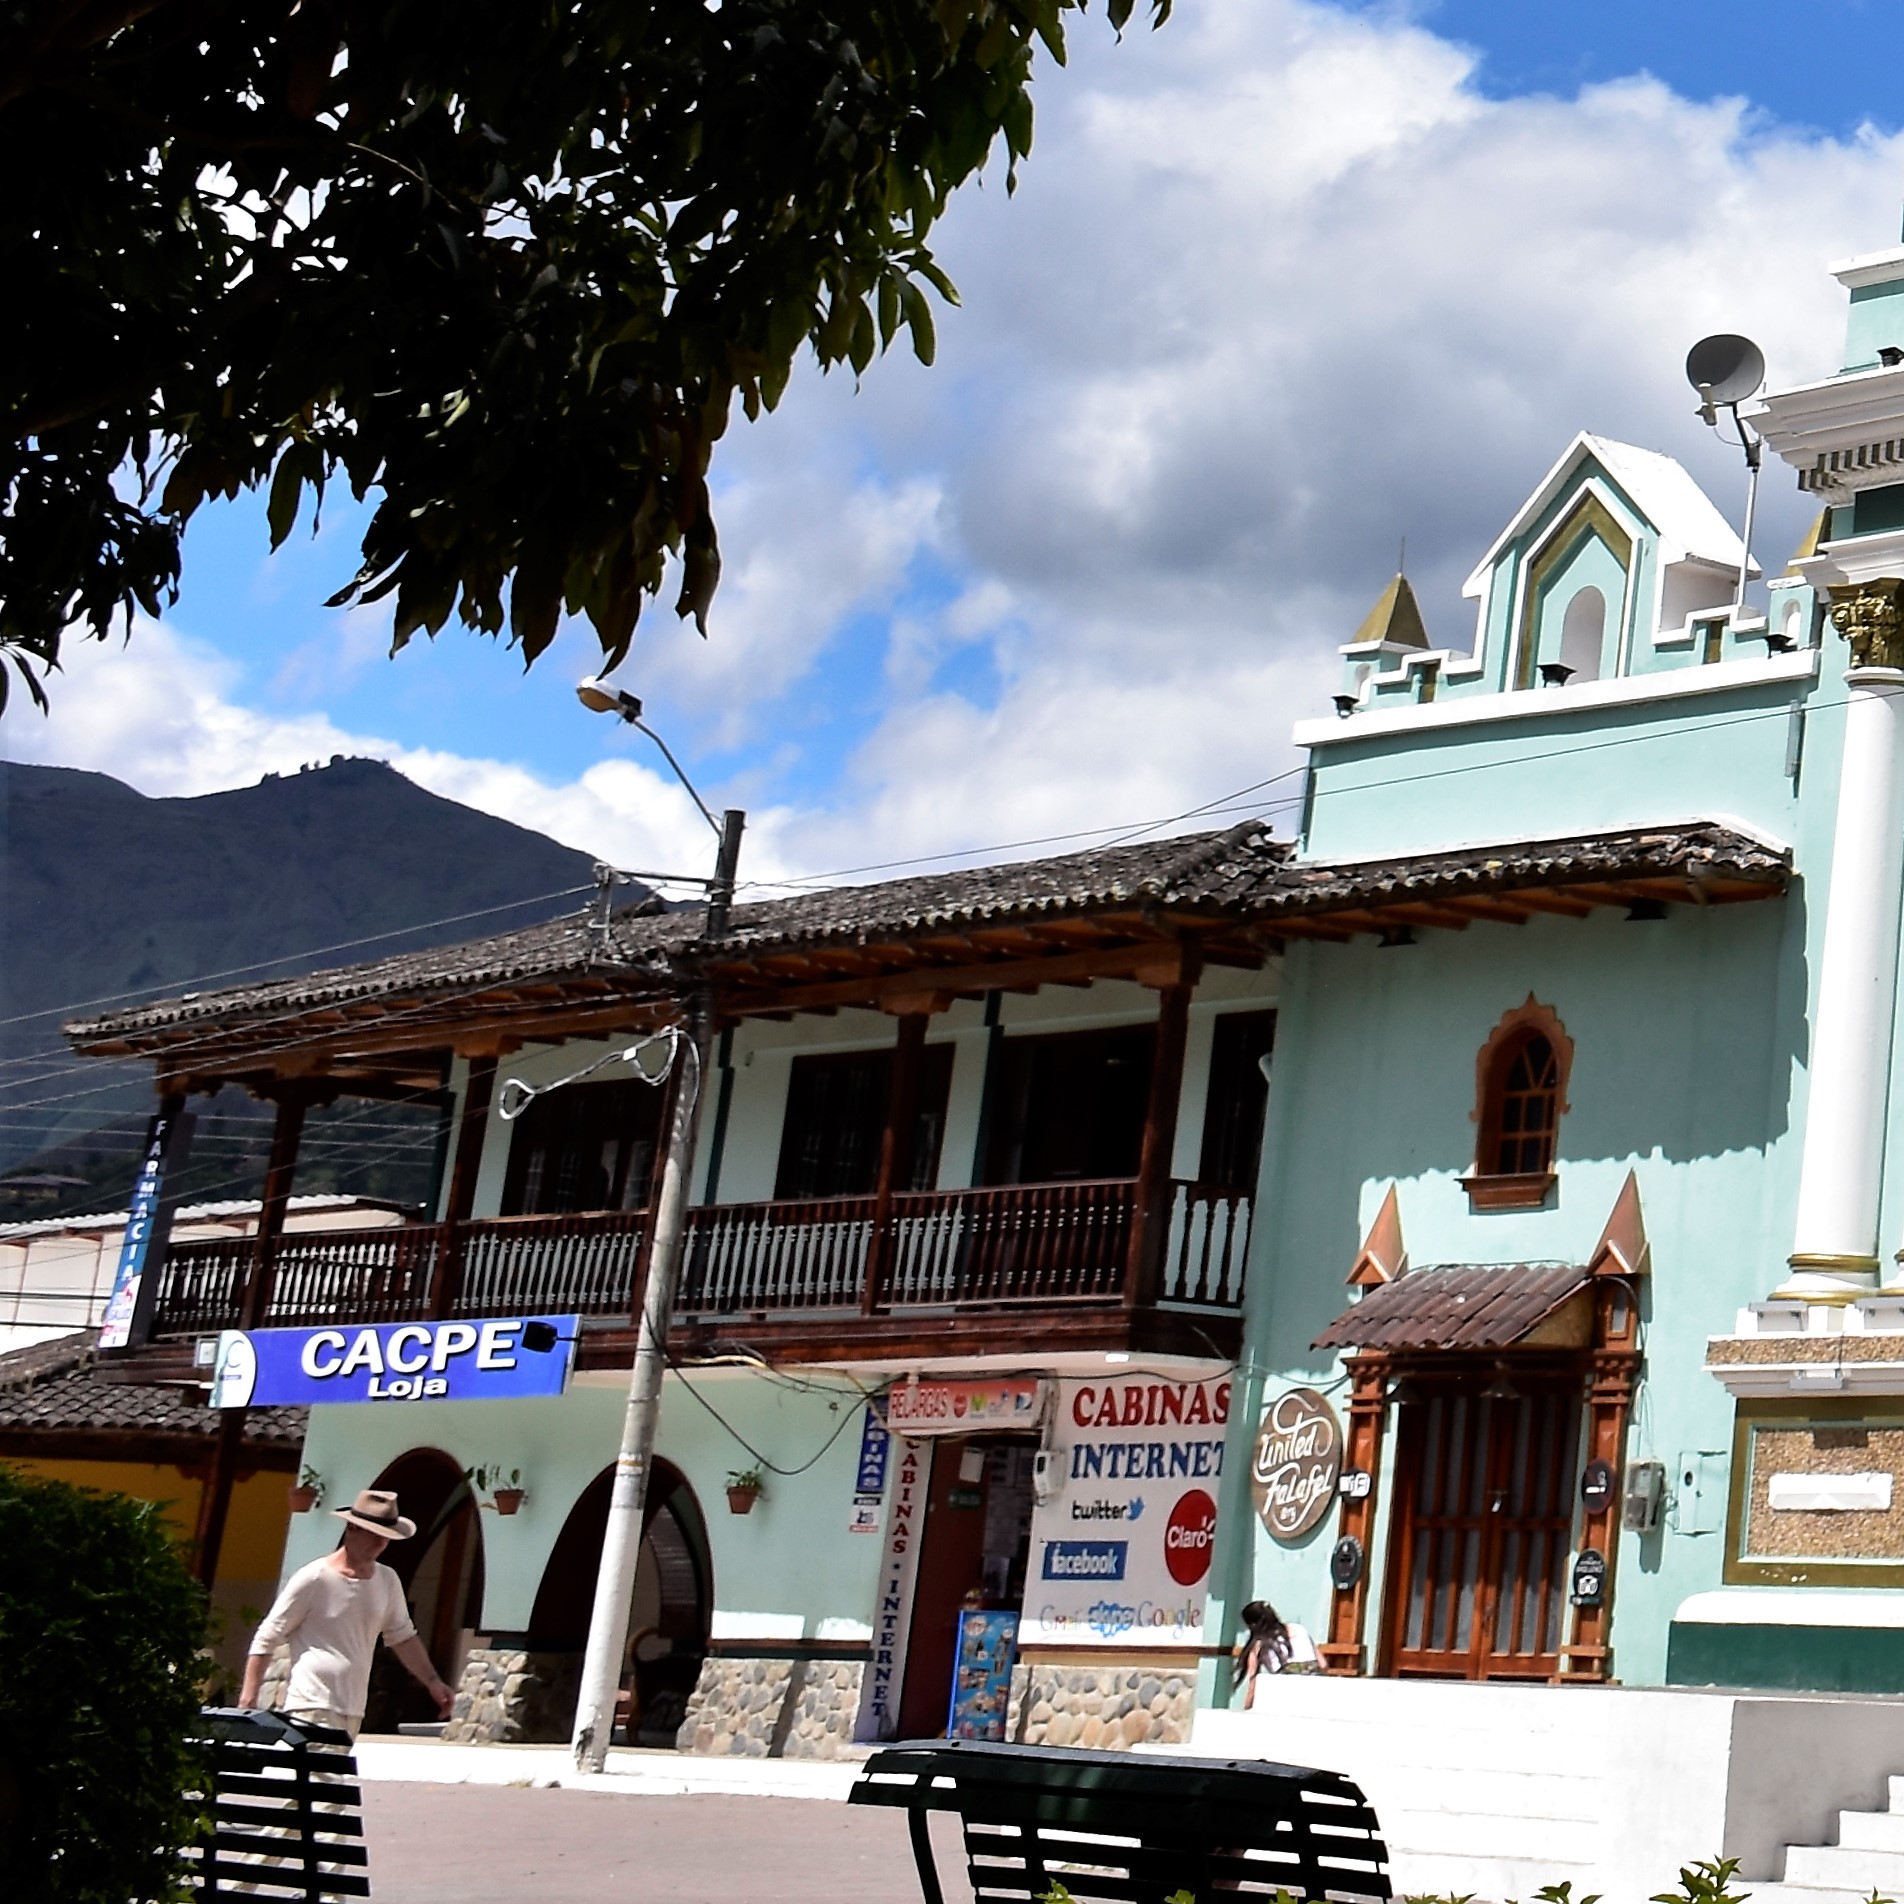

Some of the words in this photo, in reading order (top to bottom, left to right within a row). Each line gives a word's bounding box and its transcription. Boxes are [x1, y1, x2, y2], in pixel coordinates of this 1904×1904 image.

[122, 1120, 167, 1281] FARMACIA
[300, 1321, 522, 1378] CACPE
[367, 1375, 448, 1400] Loja
[1072, 1382, 1232, 1427] CABINAS
[1072, 1499, 1128, 1520] twitter
[1167, 1525, 1208, 1549] Claro
[1051, 1544, 1118, 1575] facebook
[1138, 1599, 1201, 1640] Google
[871, 1580, 900, 1716] INTERNET
